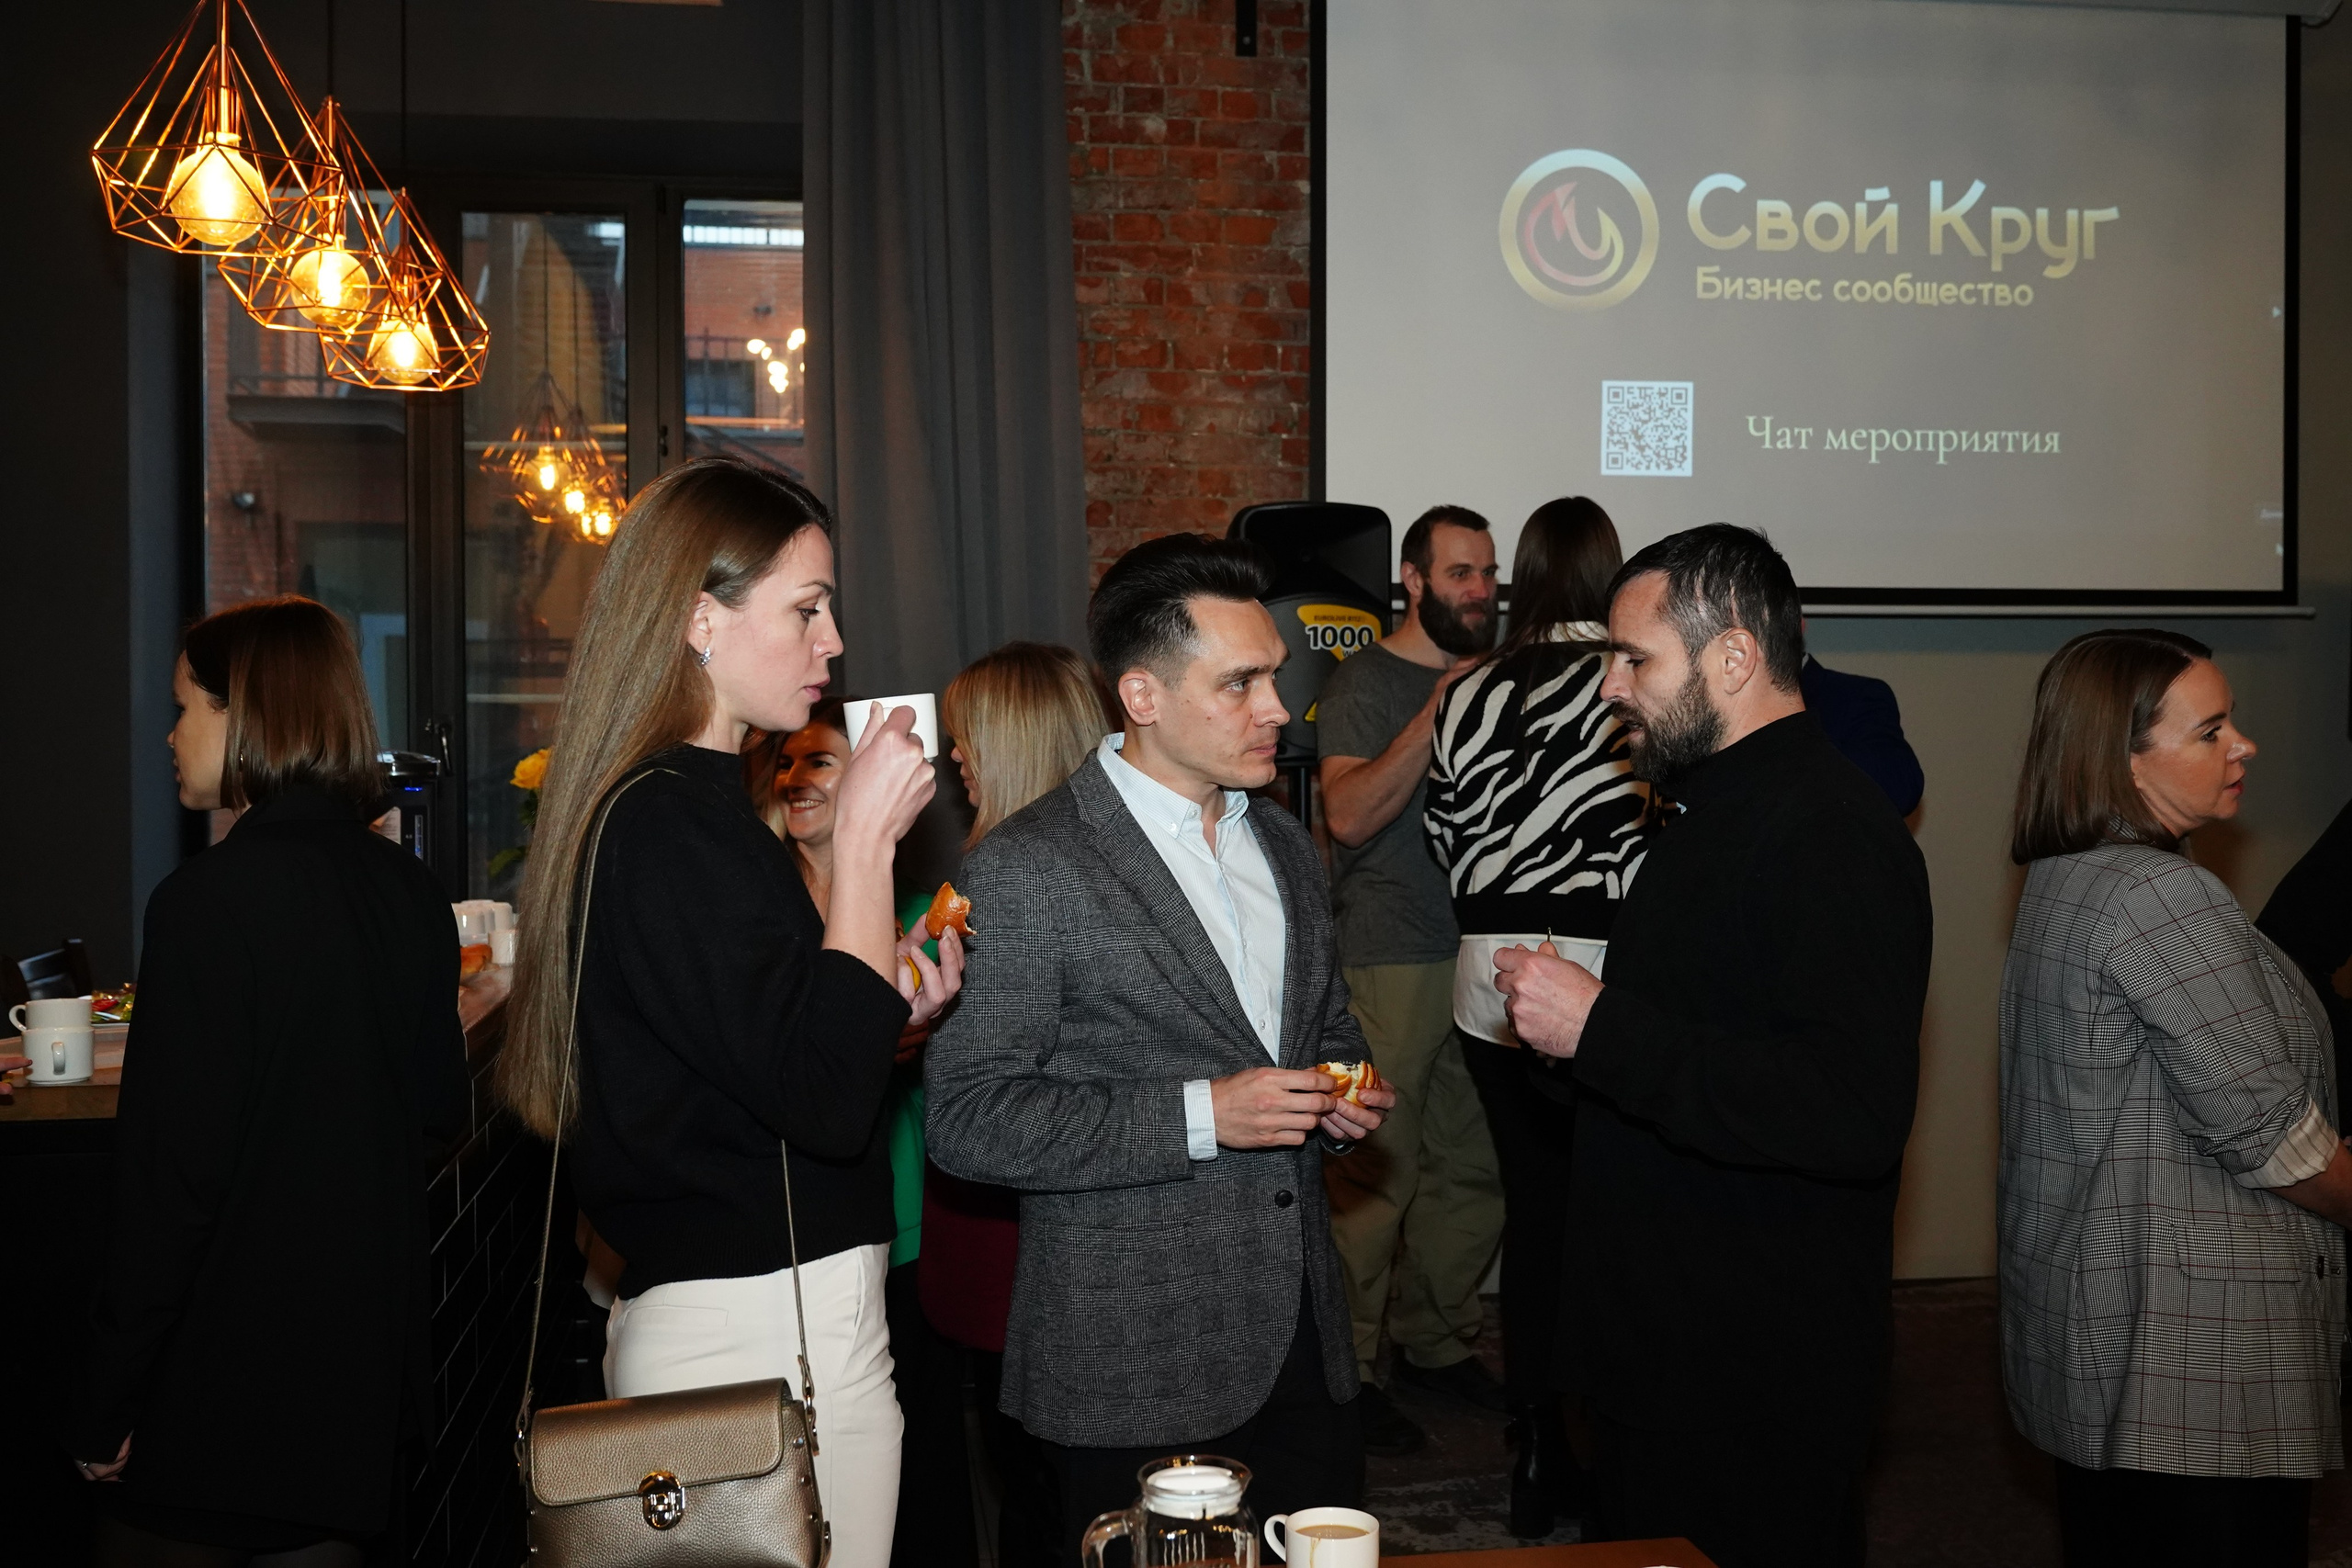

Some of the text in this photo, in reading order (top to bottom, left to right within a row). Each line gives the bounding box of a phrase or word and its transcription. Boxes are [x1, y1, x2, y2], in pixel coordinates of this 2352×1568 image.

[1687, 172, 2120, 279] Свой Круг
[1696, 265, 2034, 307] Бизнес сообщество
[1747, 414, 2062, 465] Чат мероприятия
[1306, 625, 1374, 649] 1000
